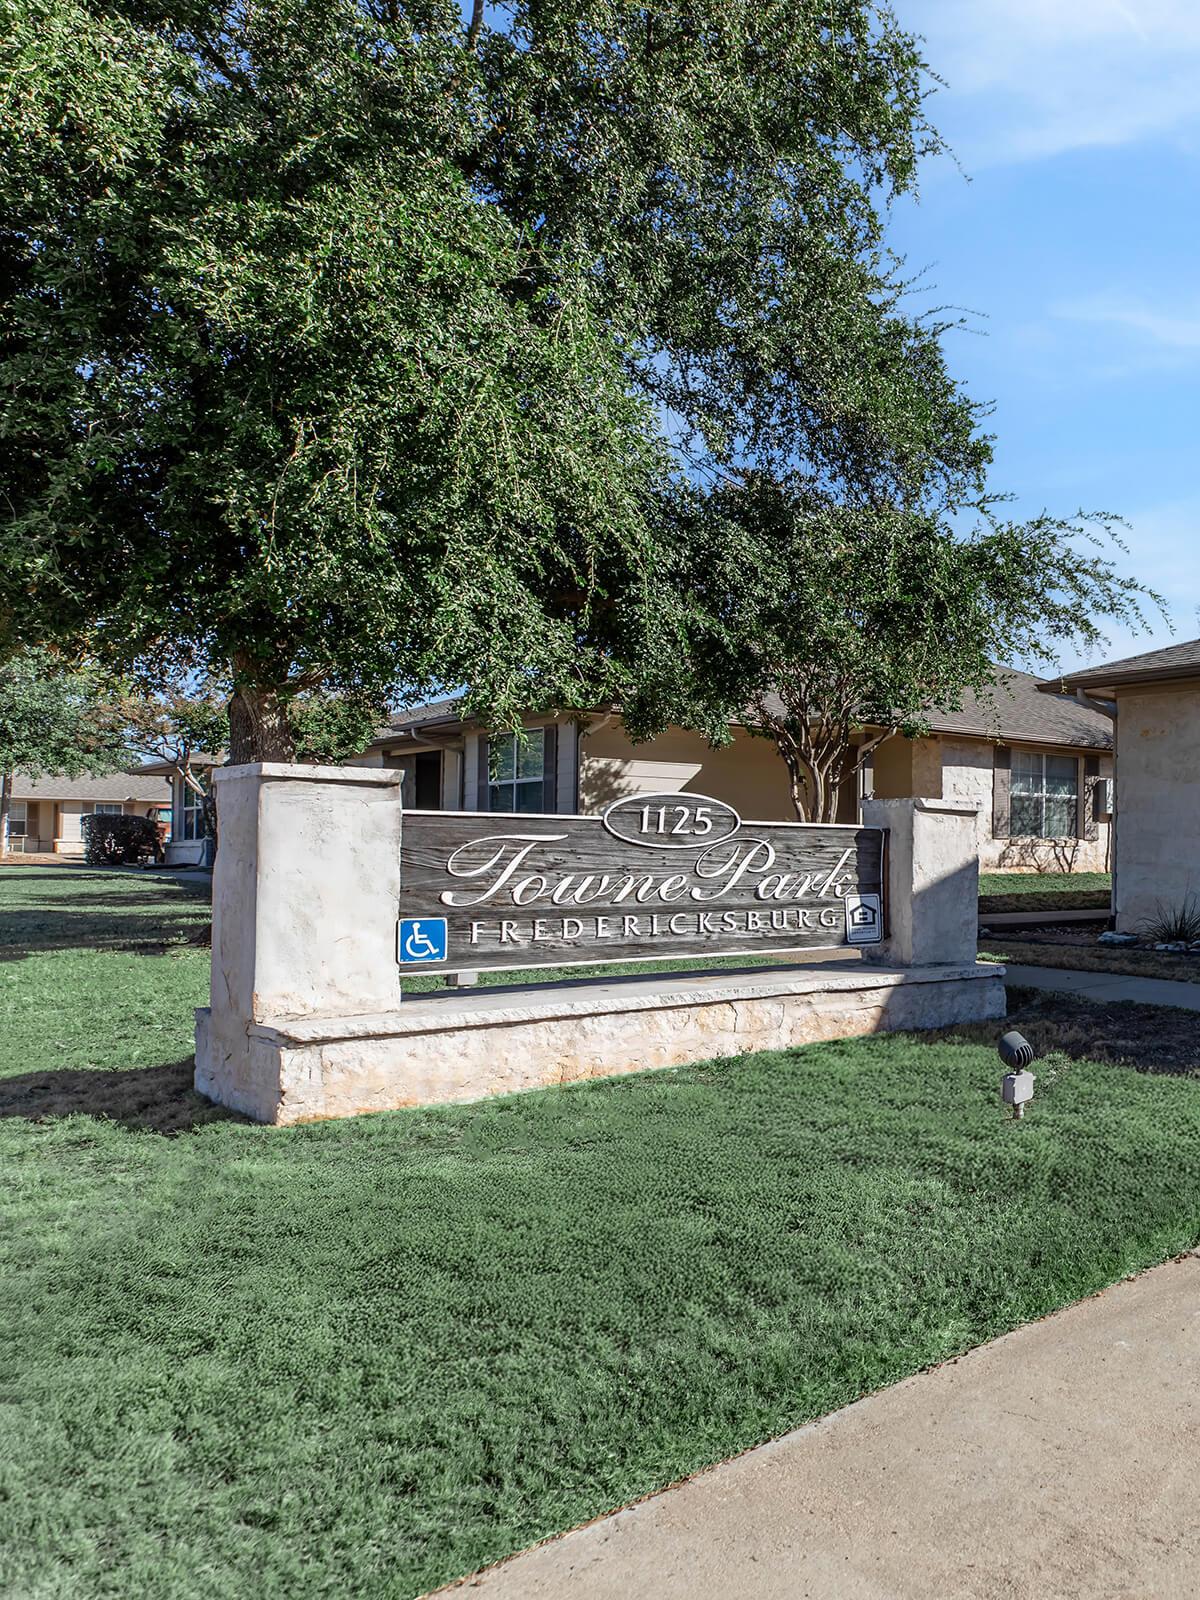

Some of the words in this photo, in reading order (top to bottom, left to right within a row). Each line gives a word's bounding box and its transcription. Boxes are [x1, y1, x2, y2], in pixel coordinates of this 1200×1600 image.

[640, 804, 713, 834] 1125
[440, 834, 690, 907] Towne
[690, 837, 857, 901] Park
[470, 908, 837, 944] FREDERICKSBURG
